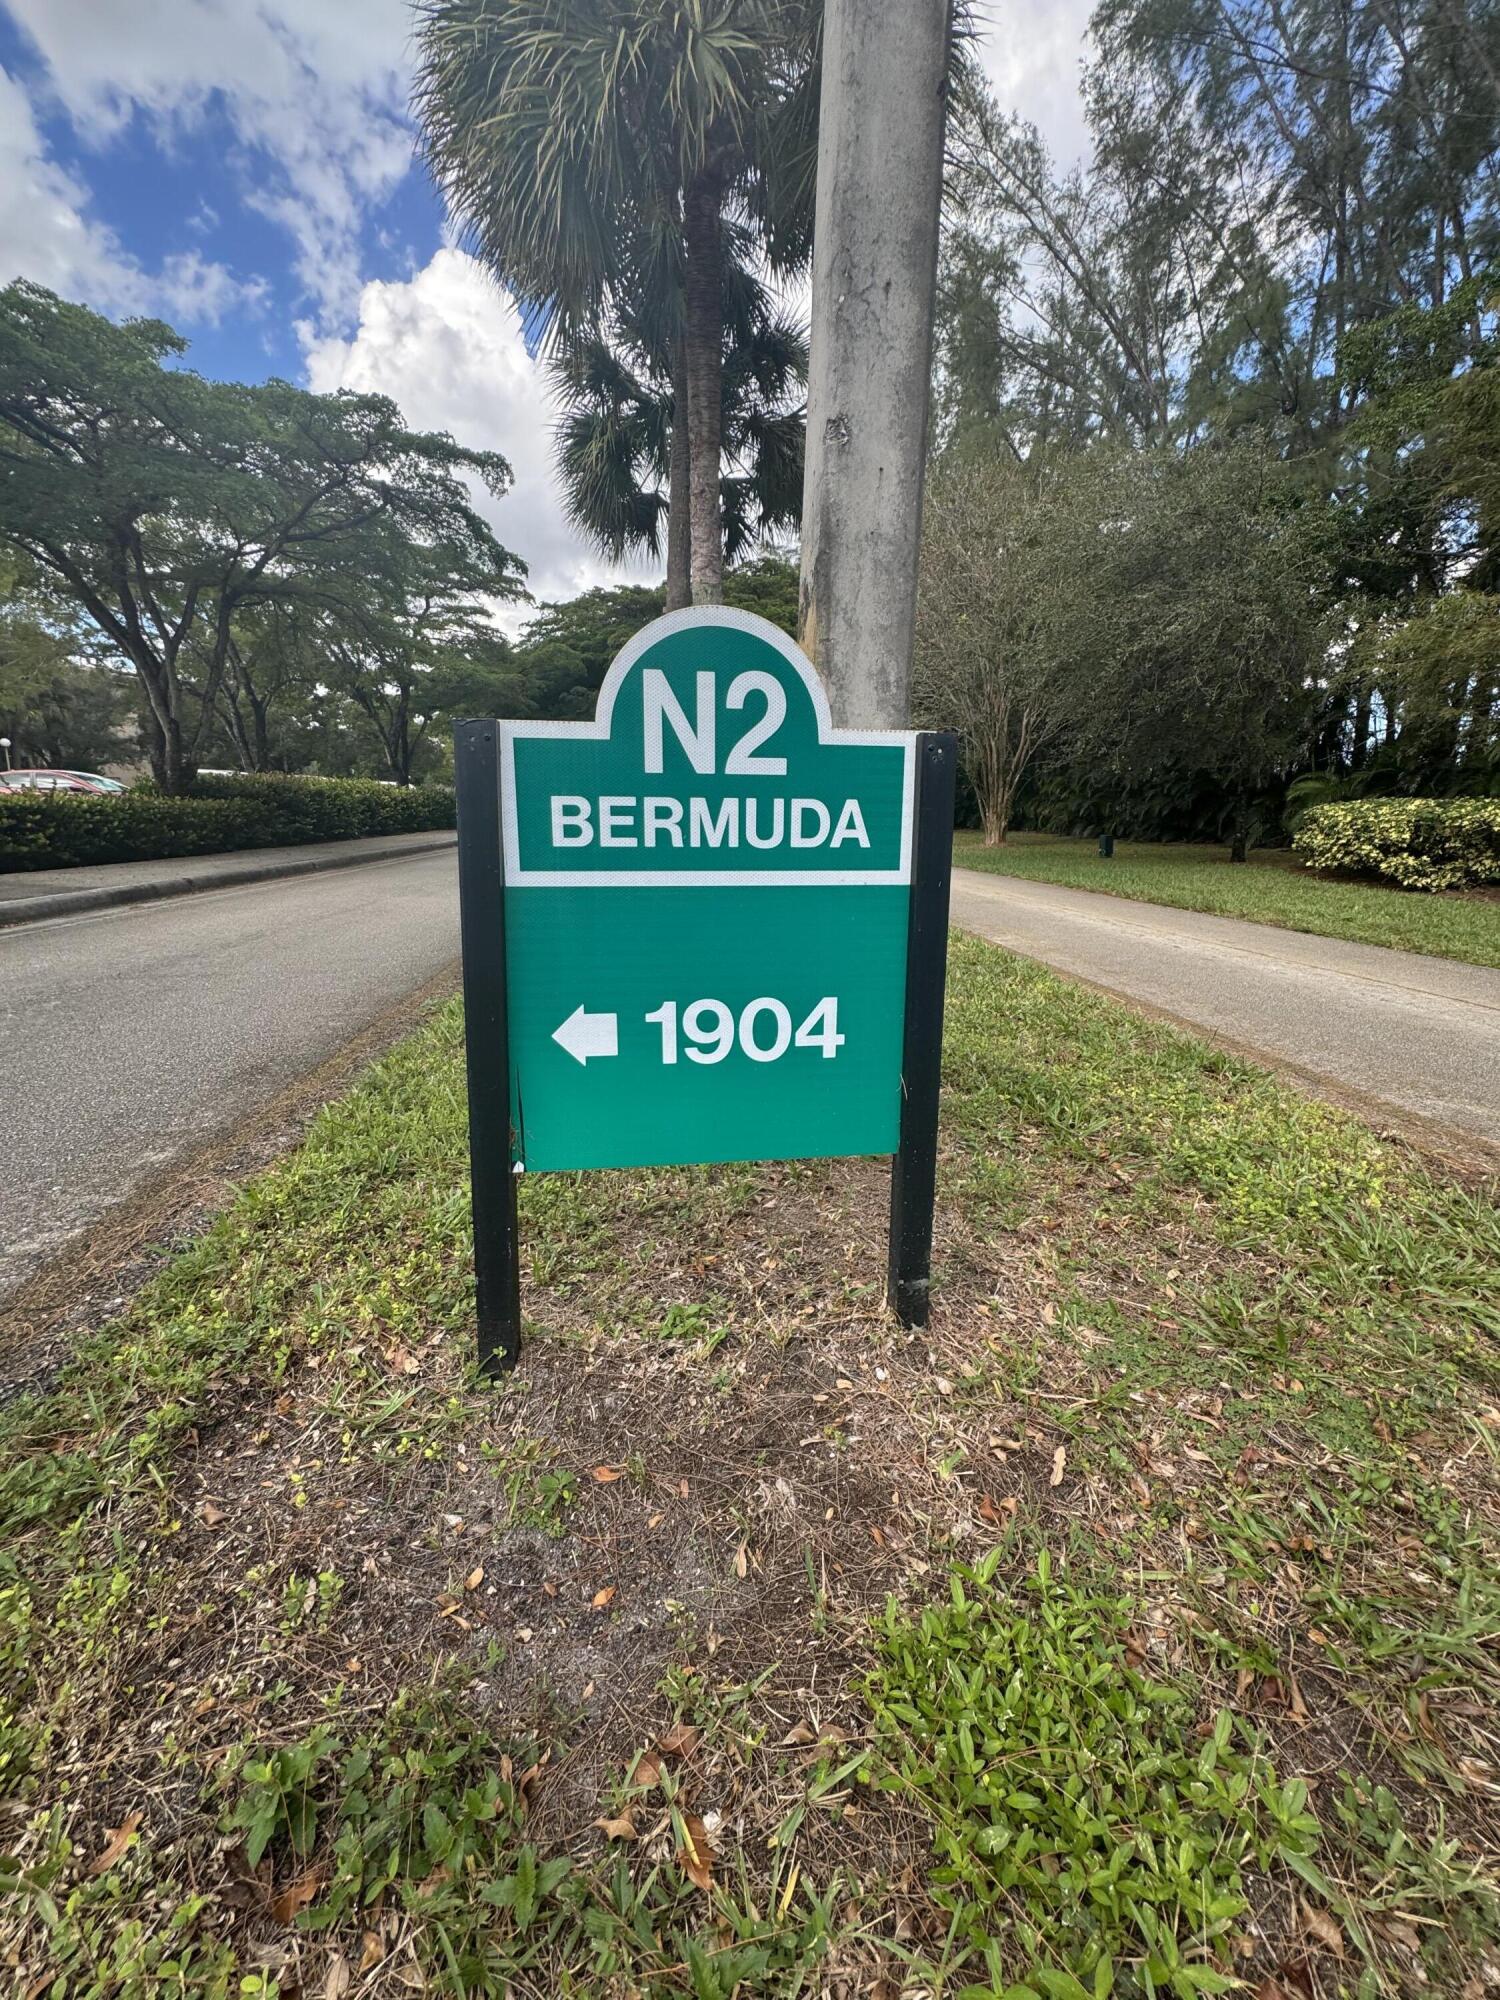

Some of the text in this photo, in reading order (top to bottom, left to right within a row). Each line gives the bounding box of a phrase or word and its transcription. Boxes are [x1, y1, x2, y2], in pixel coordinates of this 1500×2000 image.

[642, 668, 788, 776] N2
[550, 795, 871, 849] BERMUDA
[644, 996, 845, 1065] 1904
